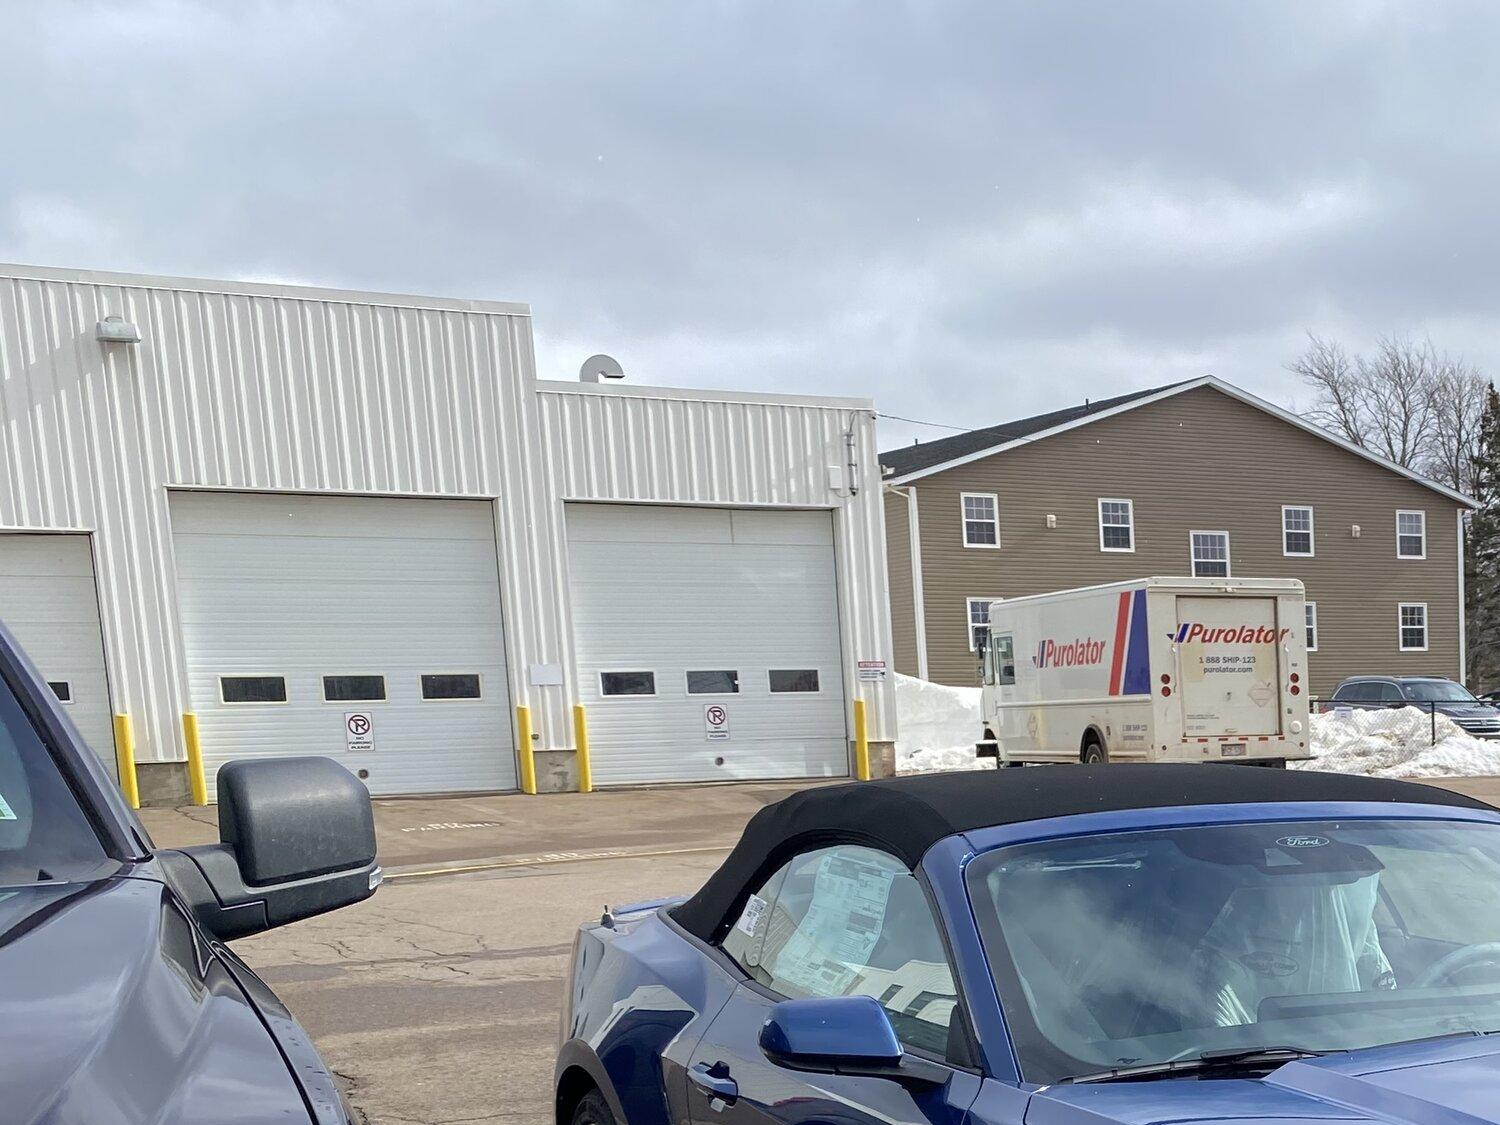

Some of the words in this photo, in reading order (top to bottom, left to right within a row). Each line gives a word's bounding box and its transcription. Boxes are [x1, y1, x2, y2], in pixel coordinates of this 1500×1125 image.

[1187, 623, 1290, 643] Purolator
[1045, 637, 1106, 668] Purolator
[1199, 656, 1204, 664] 1
[1206, 656, 1220, 664] 888
[1222, 656, 1257, 664] SHIP-123
[1203, 666, 1253, 674] purolator.com
